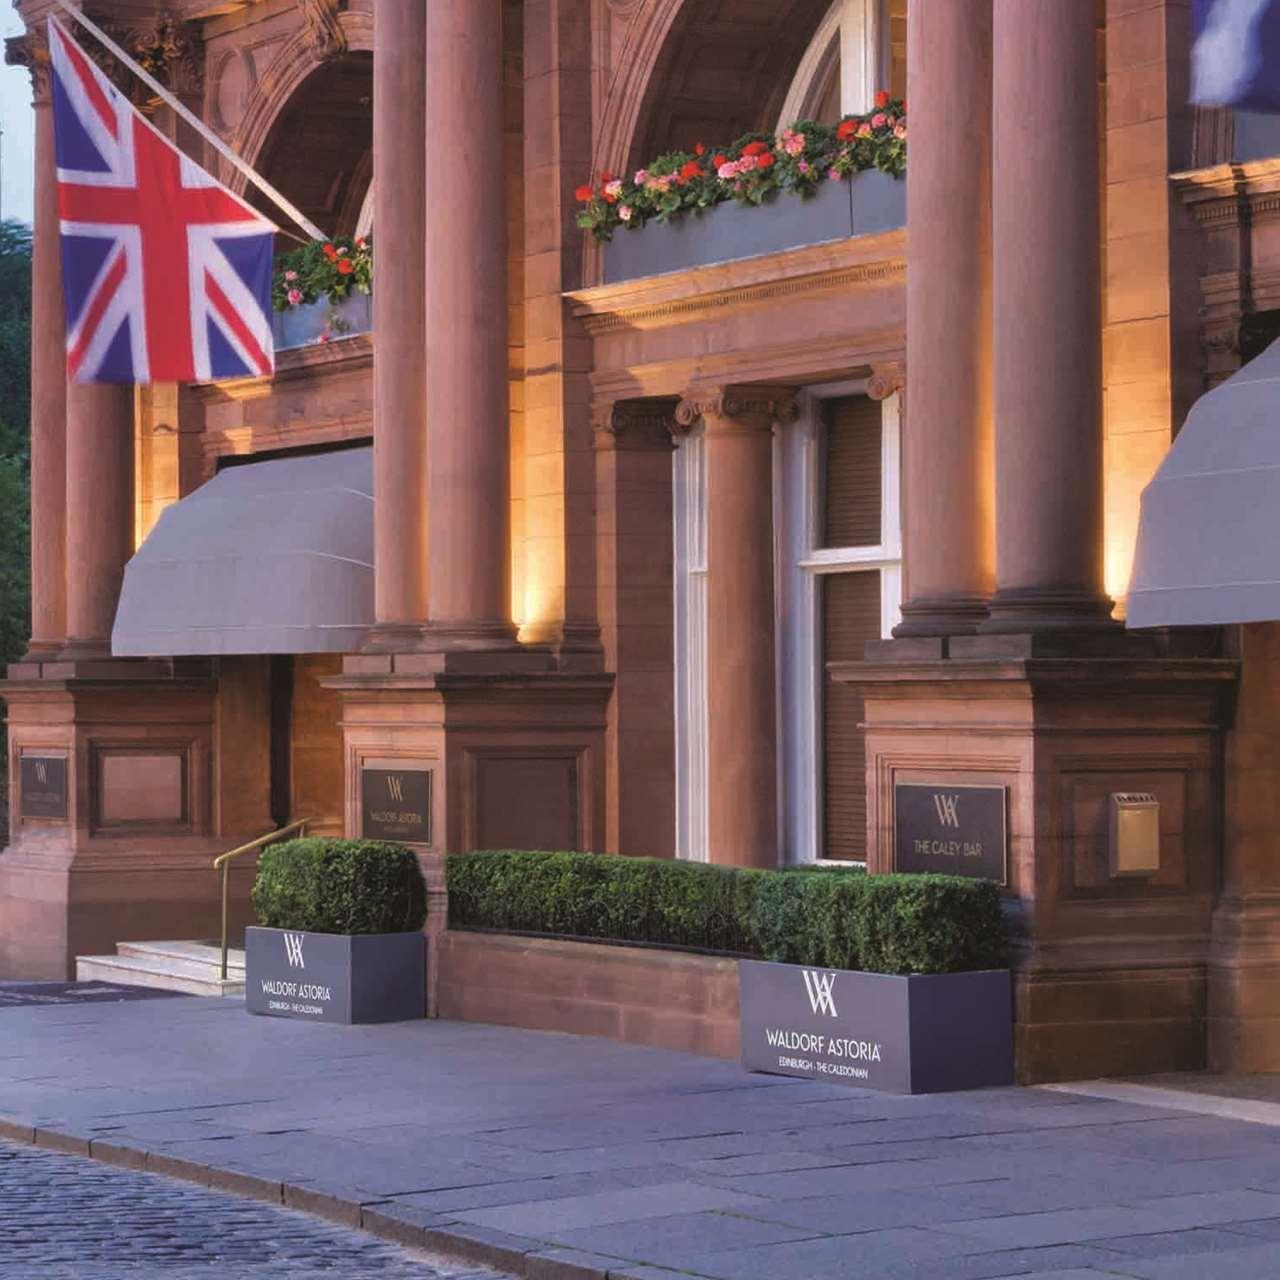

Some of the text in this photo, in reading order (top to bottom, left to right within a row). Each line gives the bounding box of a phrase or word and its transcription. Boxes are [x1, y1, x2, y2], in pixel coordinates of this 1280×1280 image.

[913, 839, 983, 857] THE CALEY BAR
[261, 979, 331, 1001] WALDORF ASTORIA
[766, 1028, 881, 1062] WALDORF ASTORIA
[779, 1055, 813, 1071] EDINBURGH
[816, 1061, 828, 1073] THE
[827, 1063, 869, 1080] CALEDONIAN
